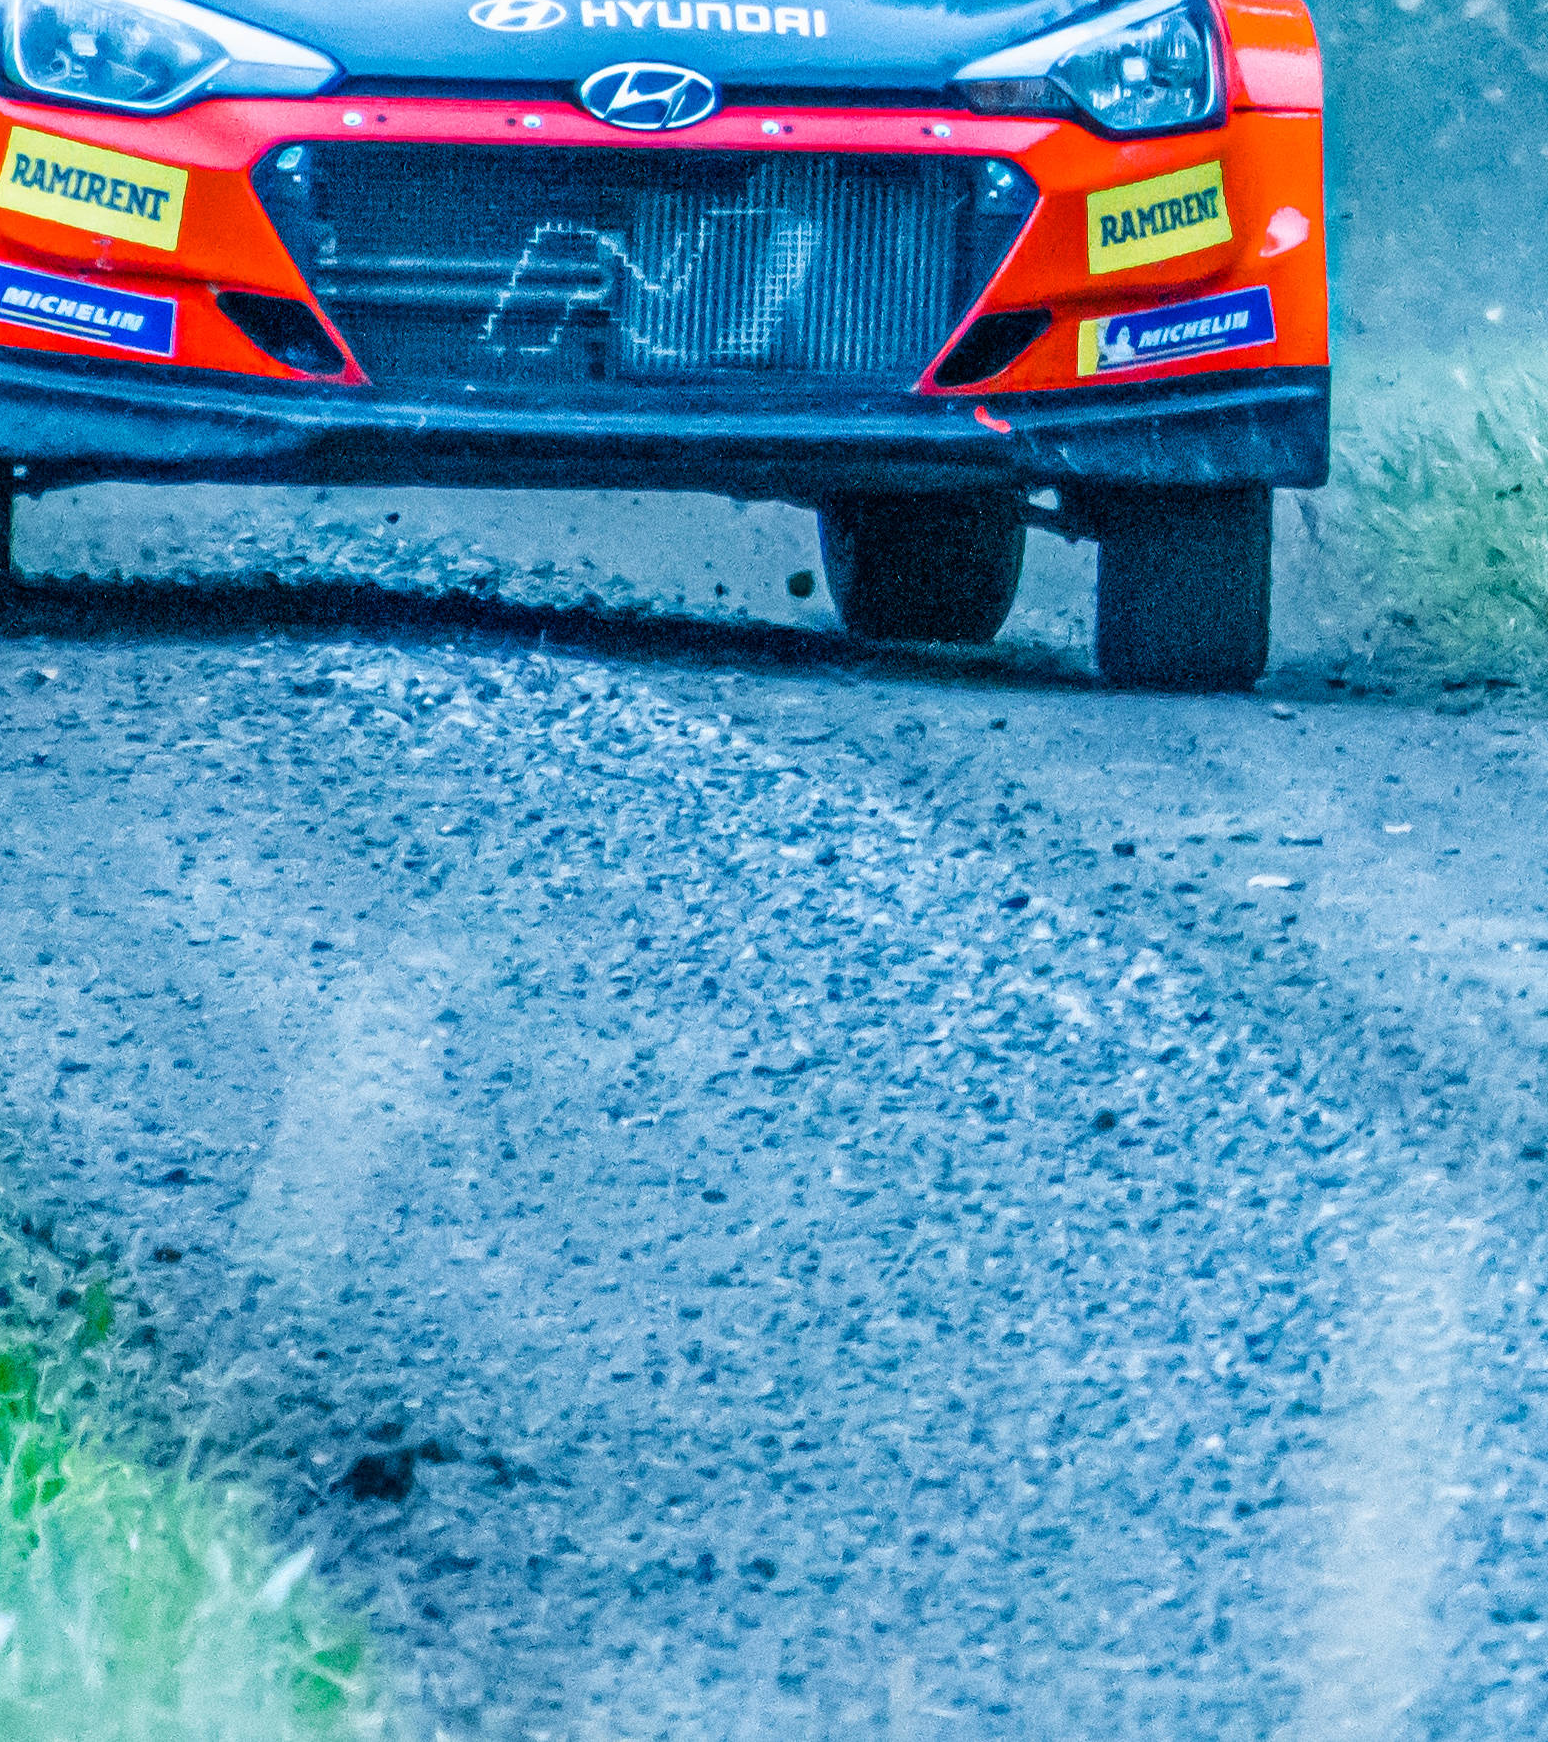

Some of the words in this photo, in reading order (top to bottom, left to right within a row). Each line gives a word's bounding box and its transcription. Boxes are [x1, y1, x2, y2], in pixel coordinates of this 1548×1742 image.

[580, 0, 827, 37] HYUNDAI
[10, 152, 171, 222] RAMIRENT
[1100, 187, 1219, 247] RAMIRENT
[1, 284, 145, 332] MICHELIN
[1138, 310, 1250, 350] MICHELIN
